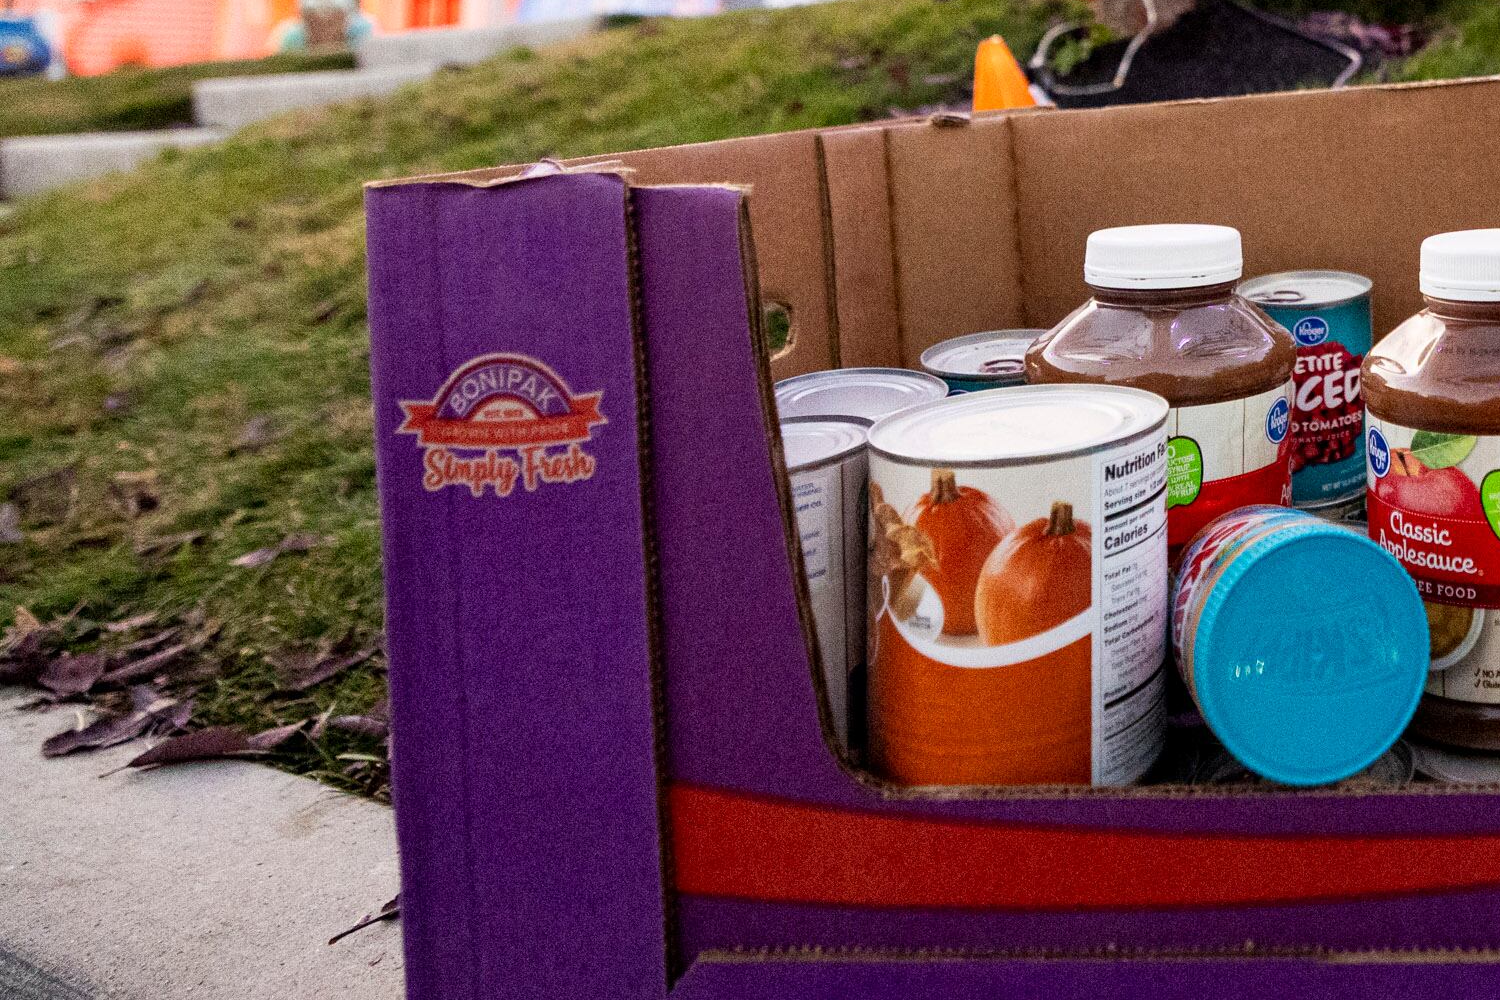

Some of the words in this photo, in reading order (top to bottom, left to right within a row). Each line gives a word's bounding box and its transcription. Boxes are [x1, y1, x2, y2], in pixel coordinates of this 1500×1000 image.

[1299, 321, 1325, 341] Kroger
[1294, 352, 1343, 374] ETITE
[450, 368, 560, 414] BONIPAK
[1292, 368, 1360, 411] ICED
[1302, 410, 1362, 432] TOMATOES
[424, 446, 520, 497] Simply
[518, 443, 597, 492] Fresh
[1105, 451, 1155, 482] Nutrition
[1104, 495, 1133, 510] Serving
[1104, 524, 1147, 550] Calories
[1390, 510, 1452, 546] Classic
[1379, 528, 1477, 574] Applesauce
[1437, 584, 1477, 599] FOOD
